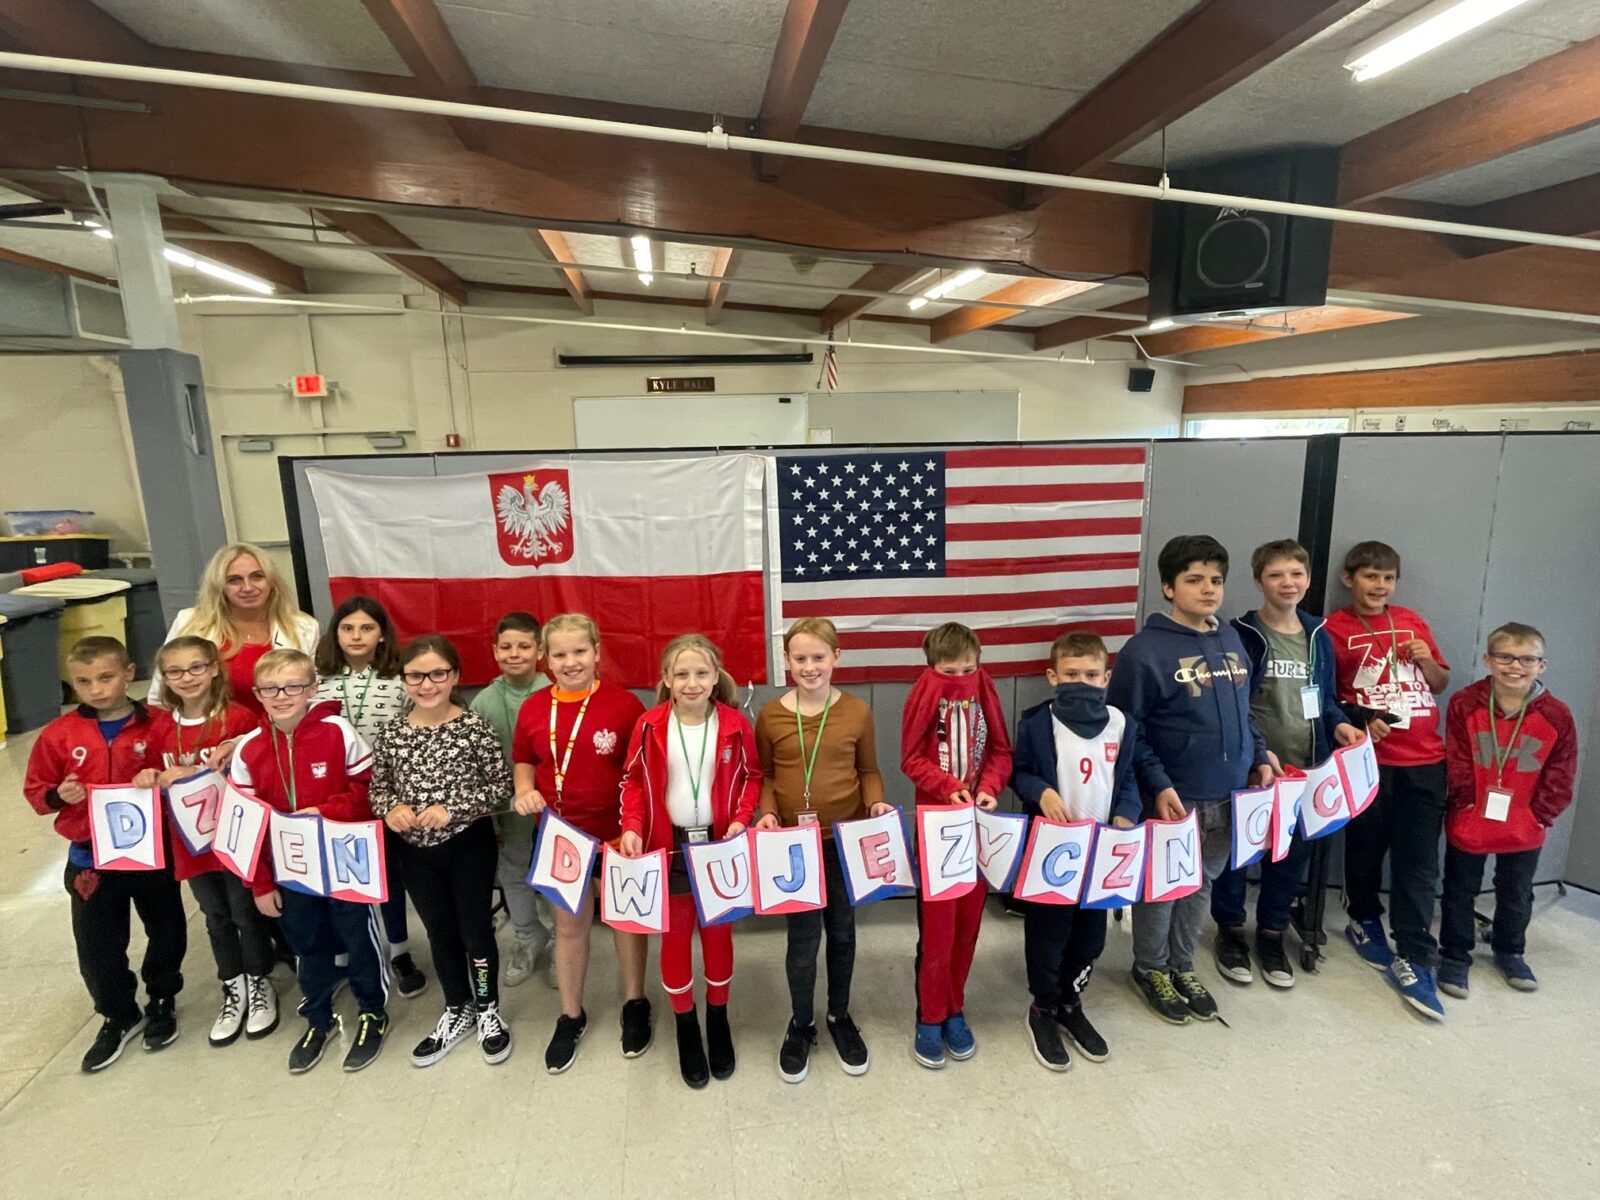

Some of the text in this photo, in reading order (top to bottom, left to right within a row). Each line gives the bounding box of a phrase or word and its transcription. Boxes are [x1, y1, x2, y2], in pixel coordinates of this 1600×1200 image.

[652, 379, 679, 391] KYLE
[71, 746, 87, 768] 9
[1079, 757, 1093, 785] 9
[476, 968, 488, 996] Hurley
